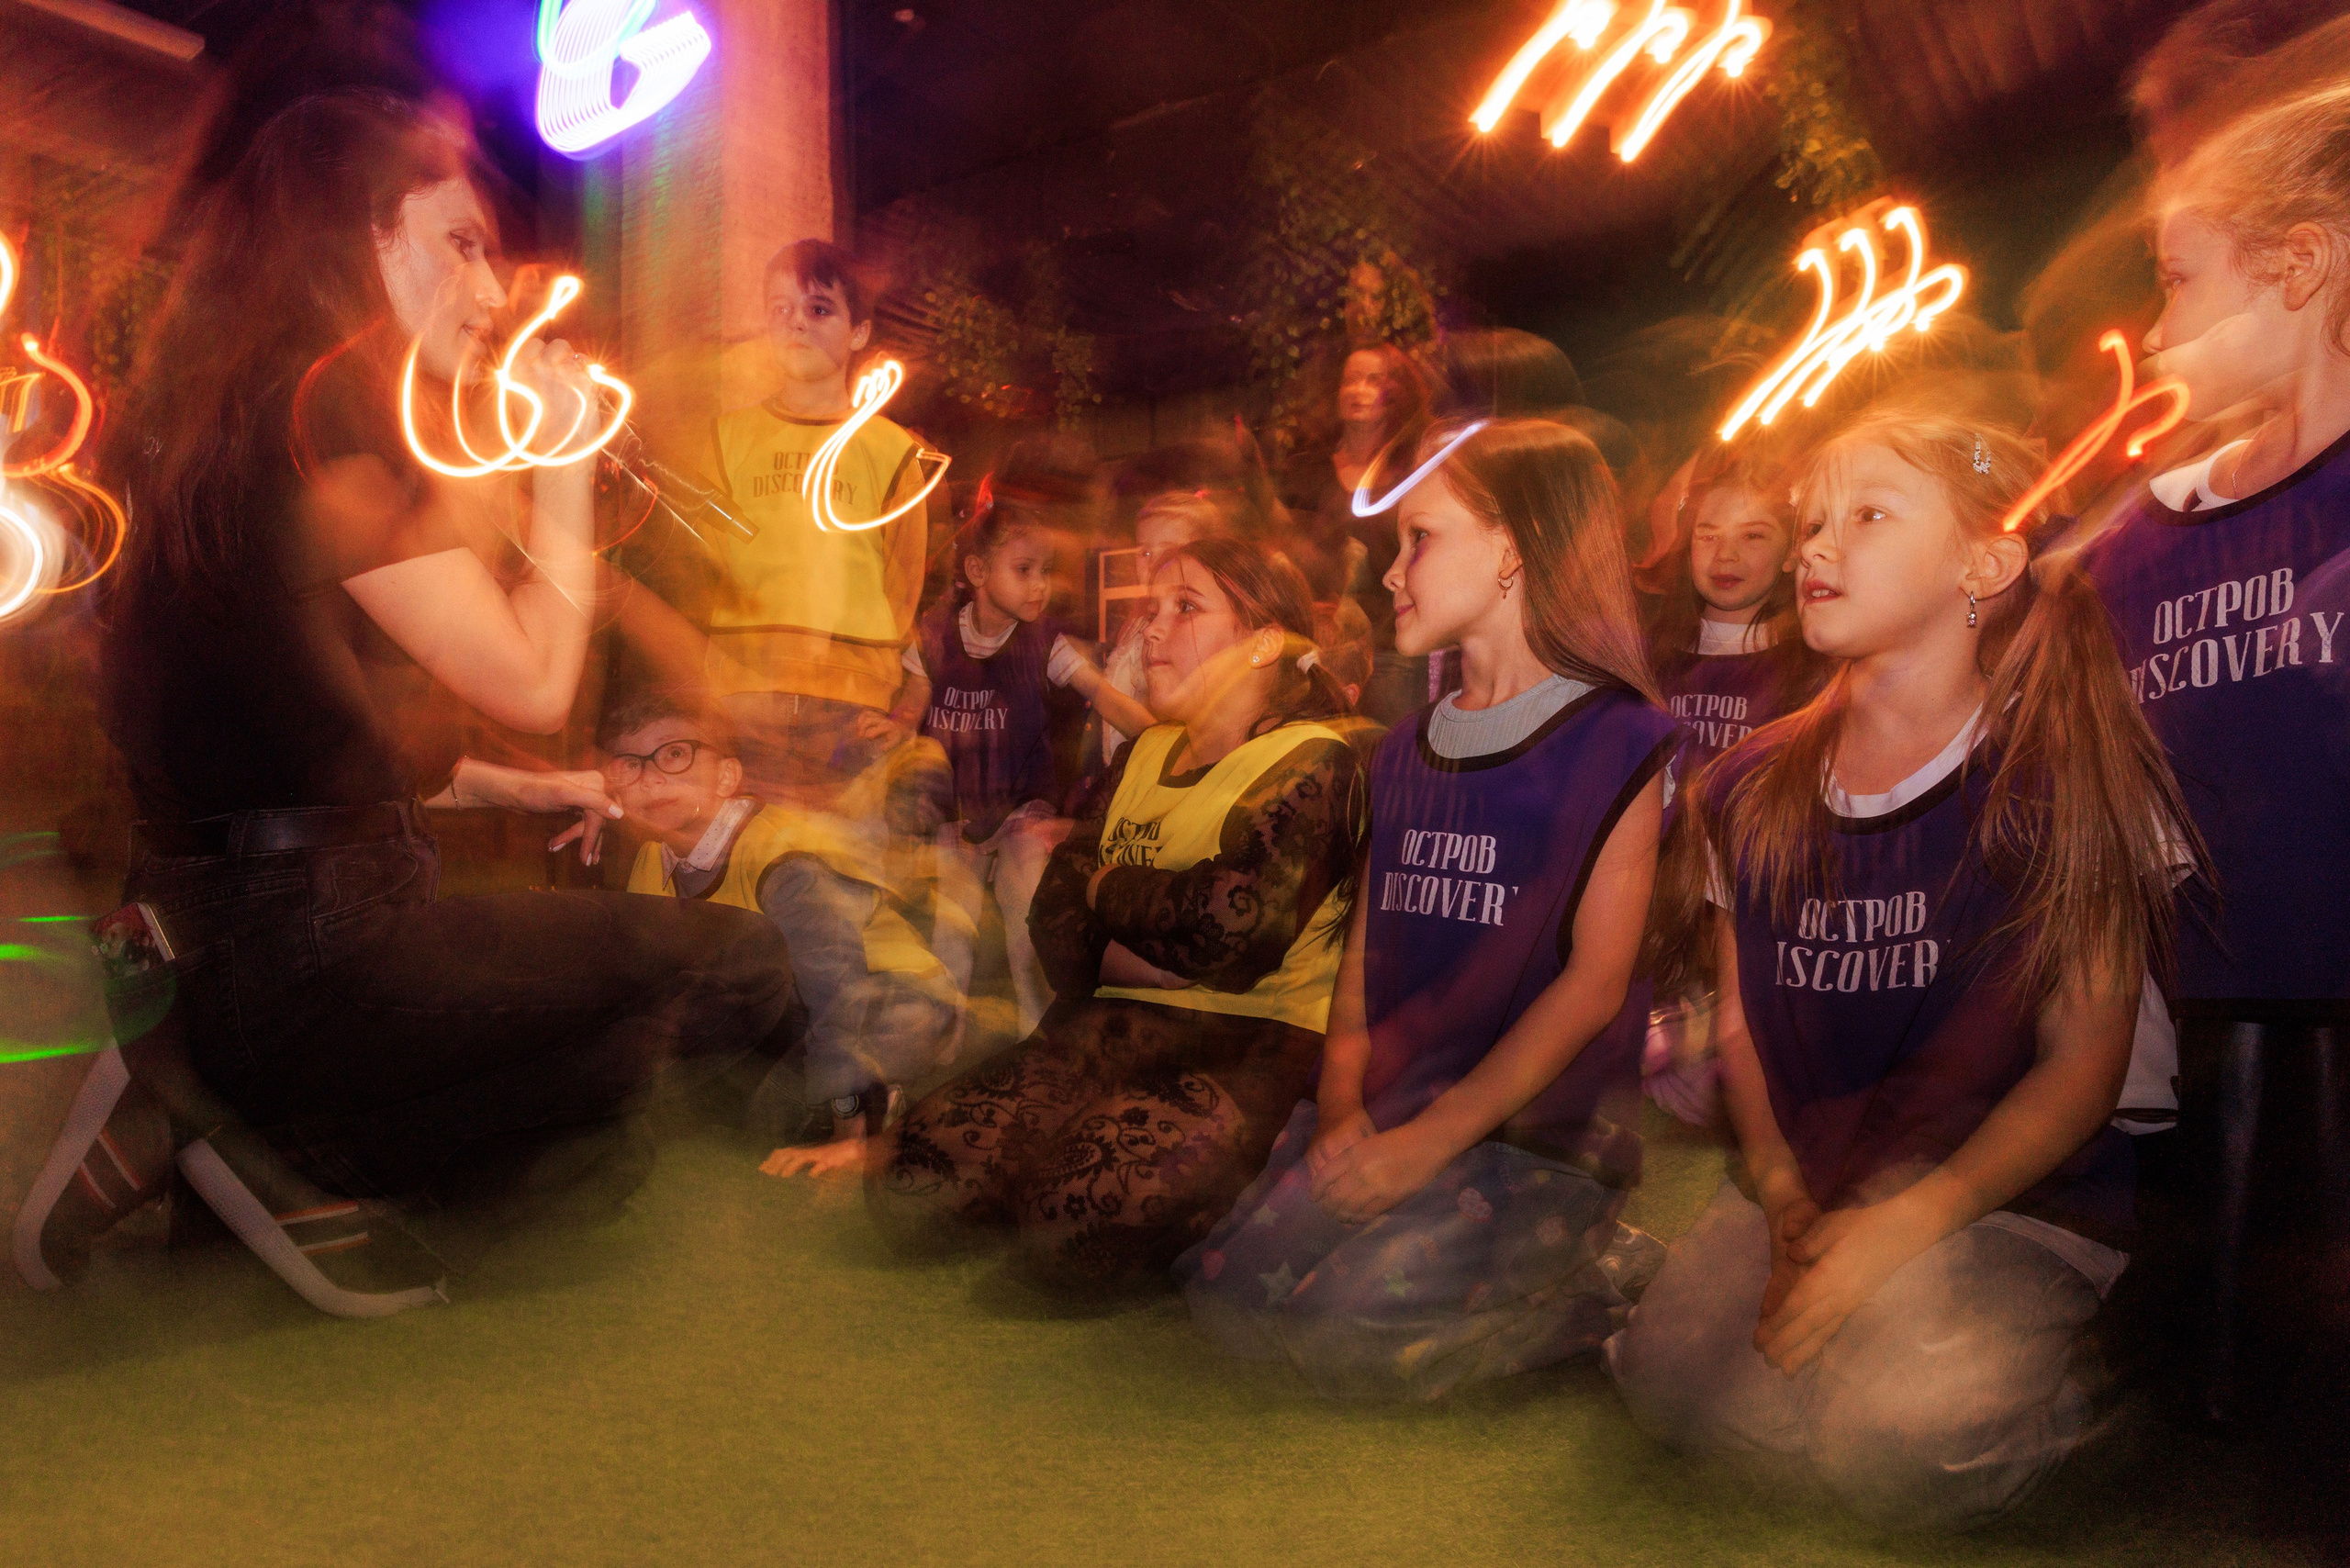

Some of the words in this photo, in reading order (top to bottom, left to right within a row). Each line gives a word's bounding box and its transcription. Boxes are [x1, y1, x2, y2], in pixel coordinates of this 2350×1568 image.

[2153, 567, 2295, 645] ОСТРОВ
[1671, 694, 1748, 721] ОСТРОВ
[1401, 829, 1497, 875] ОСТРОВ
[1380, 871, 1519, 927] DISCOVER
[1797, 890, 1927, 943] ОСТРОВ
[1775, 938, 1951, 993] ISCOVER
